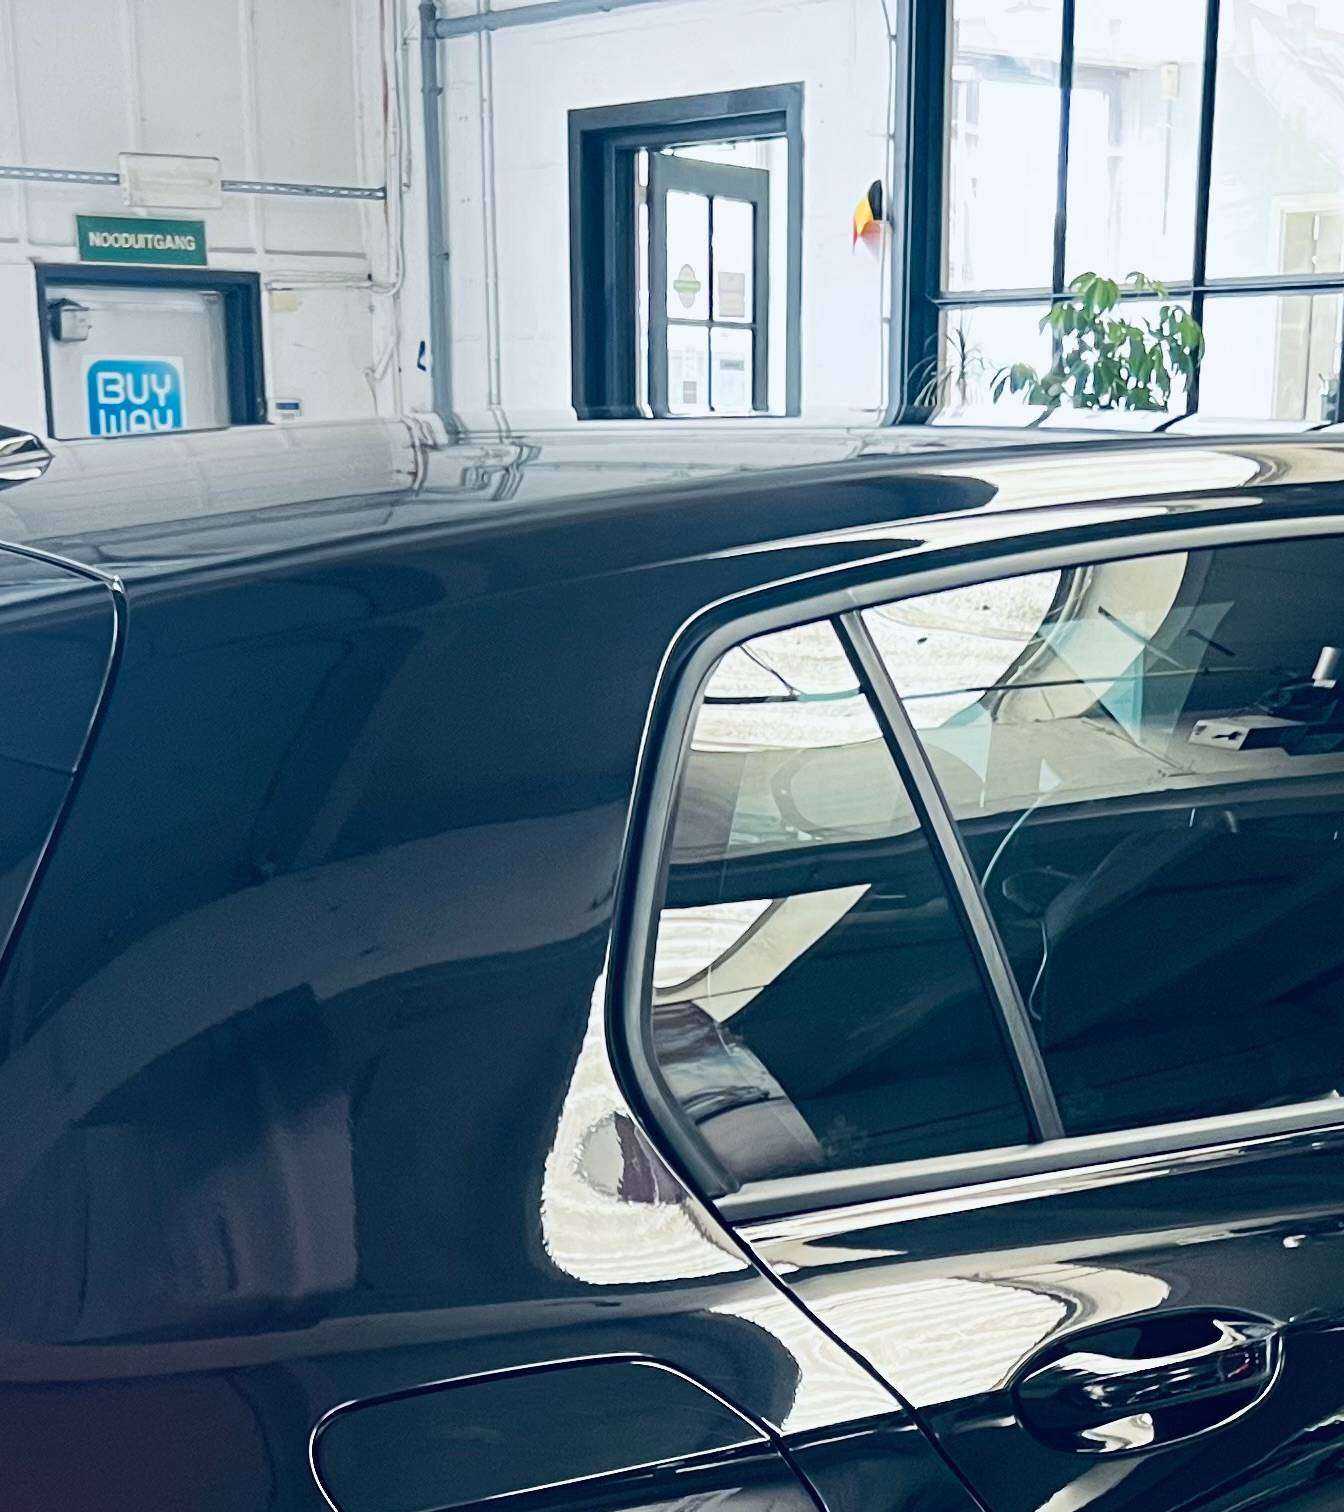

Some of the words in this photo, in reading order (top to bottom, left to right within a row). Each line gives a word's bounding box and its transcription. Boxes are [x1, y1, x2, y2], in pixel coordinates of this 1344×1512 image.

[88, 231, 196, 251] NOODUITGANG
[96, 371, 171, 406] BUY
[99, 409, 174, 434] WAY
